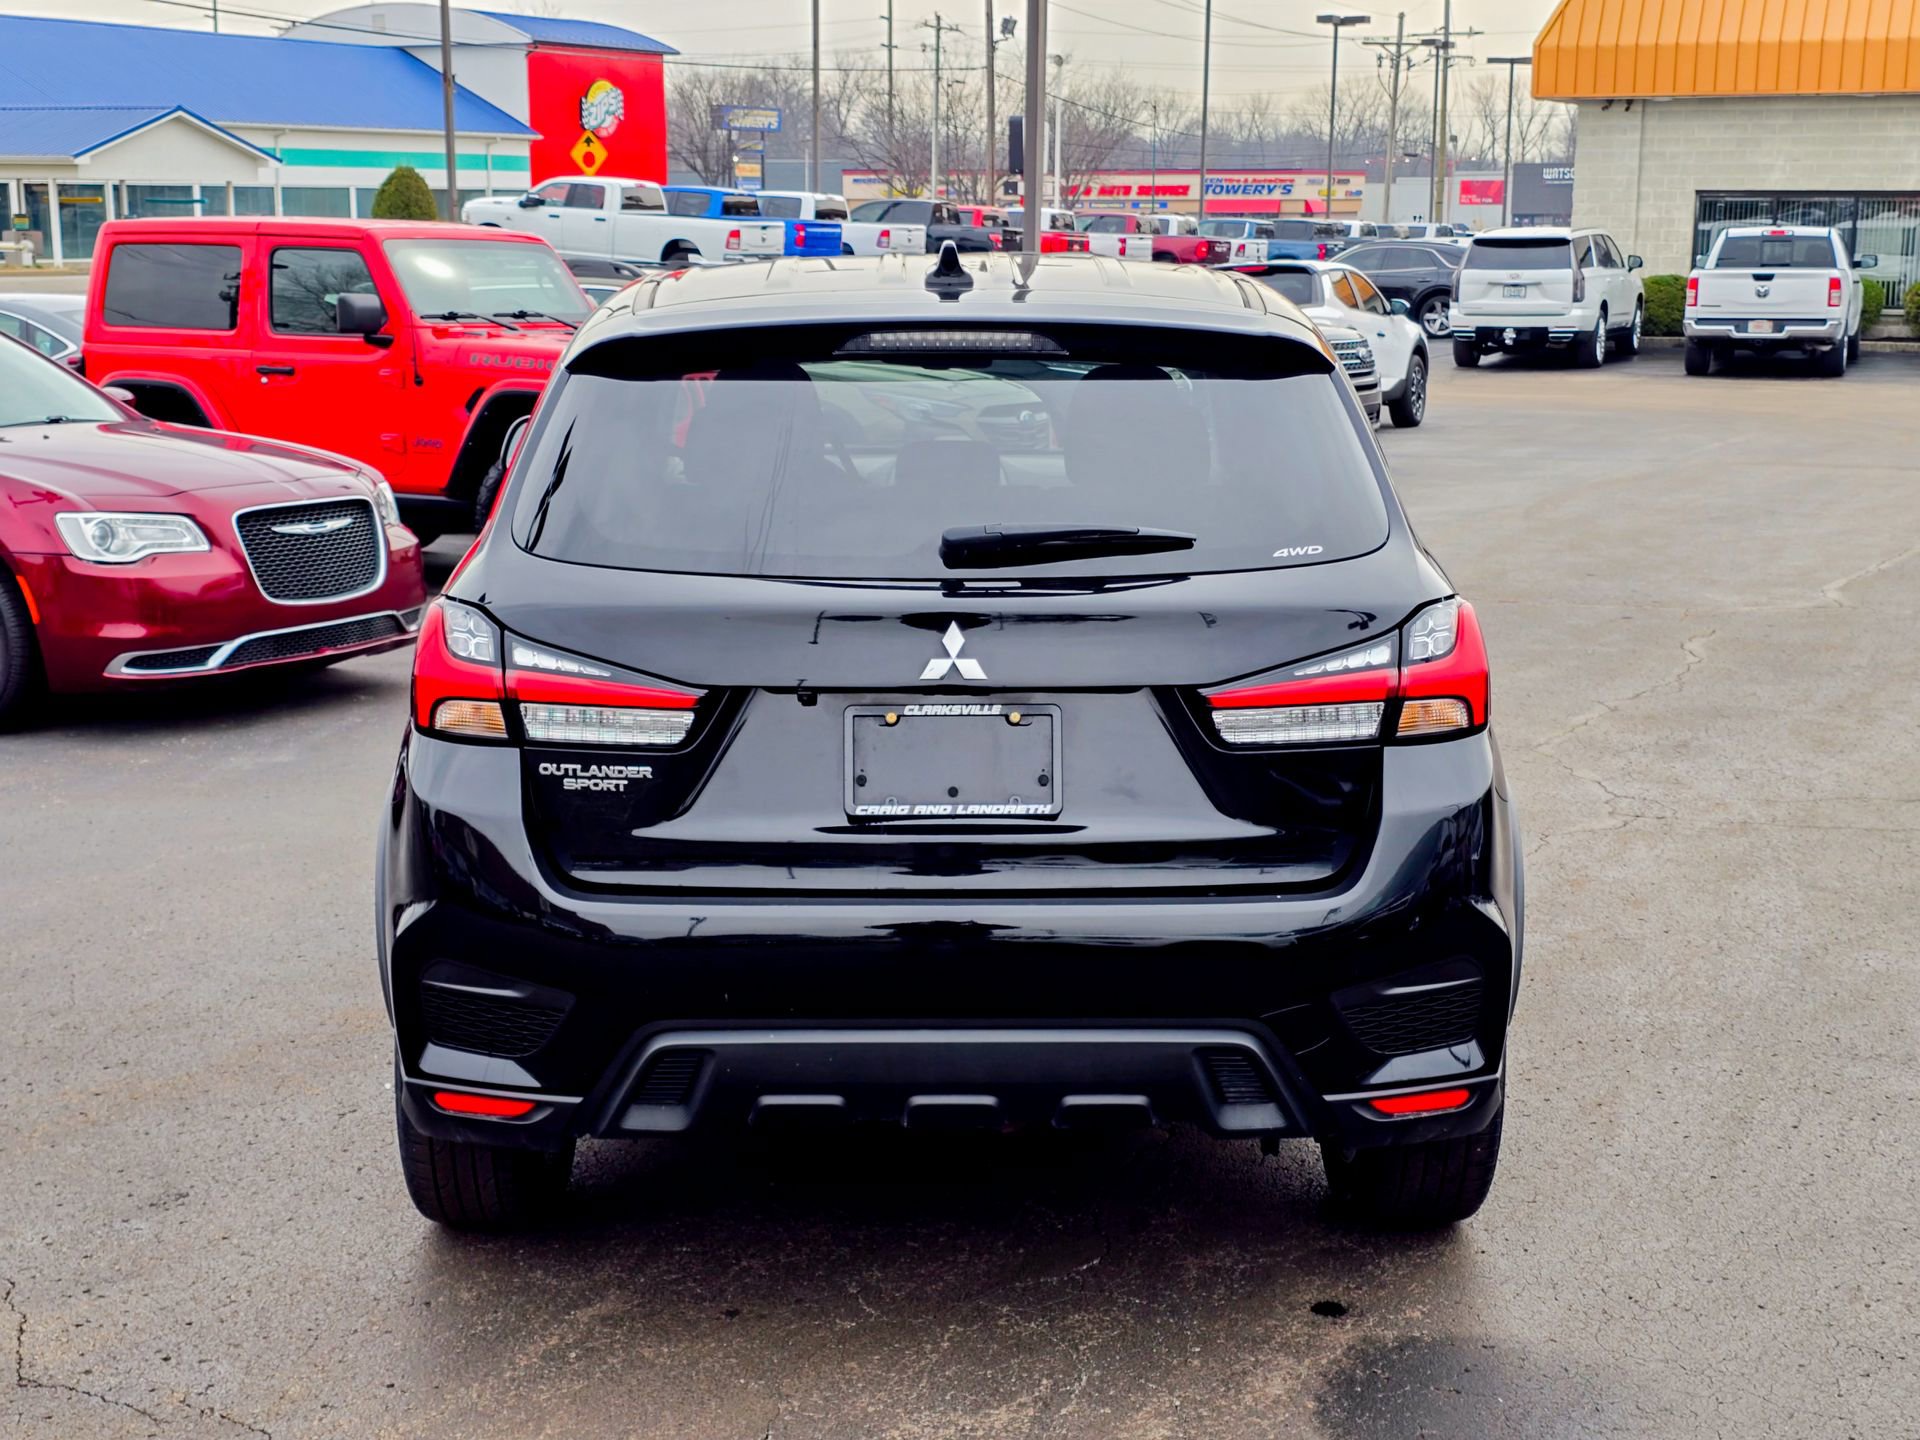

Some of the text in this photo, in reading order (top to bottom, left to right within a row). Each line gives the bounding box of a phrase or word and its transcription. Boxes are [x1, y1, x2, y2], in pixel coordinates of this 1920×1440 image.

[1204, 183, 1294, 195] TOWERY'S
[1272, 545, 1324, 557] 4WD
[903, 705, 1002, 716] CLARKSVILLE
[538, 763, 653, 779] OUTLANDER
[563, 778, 628, 791] SPORT
[855, 804, 1051, 815] CRAIG AND LANDRETH
